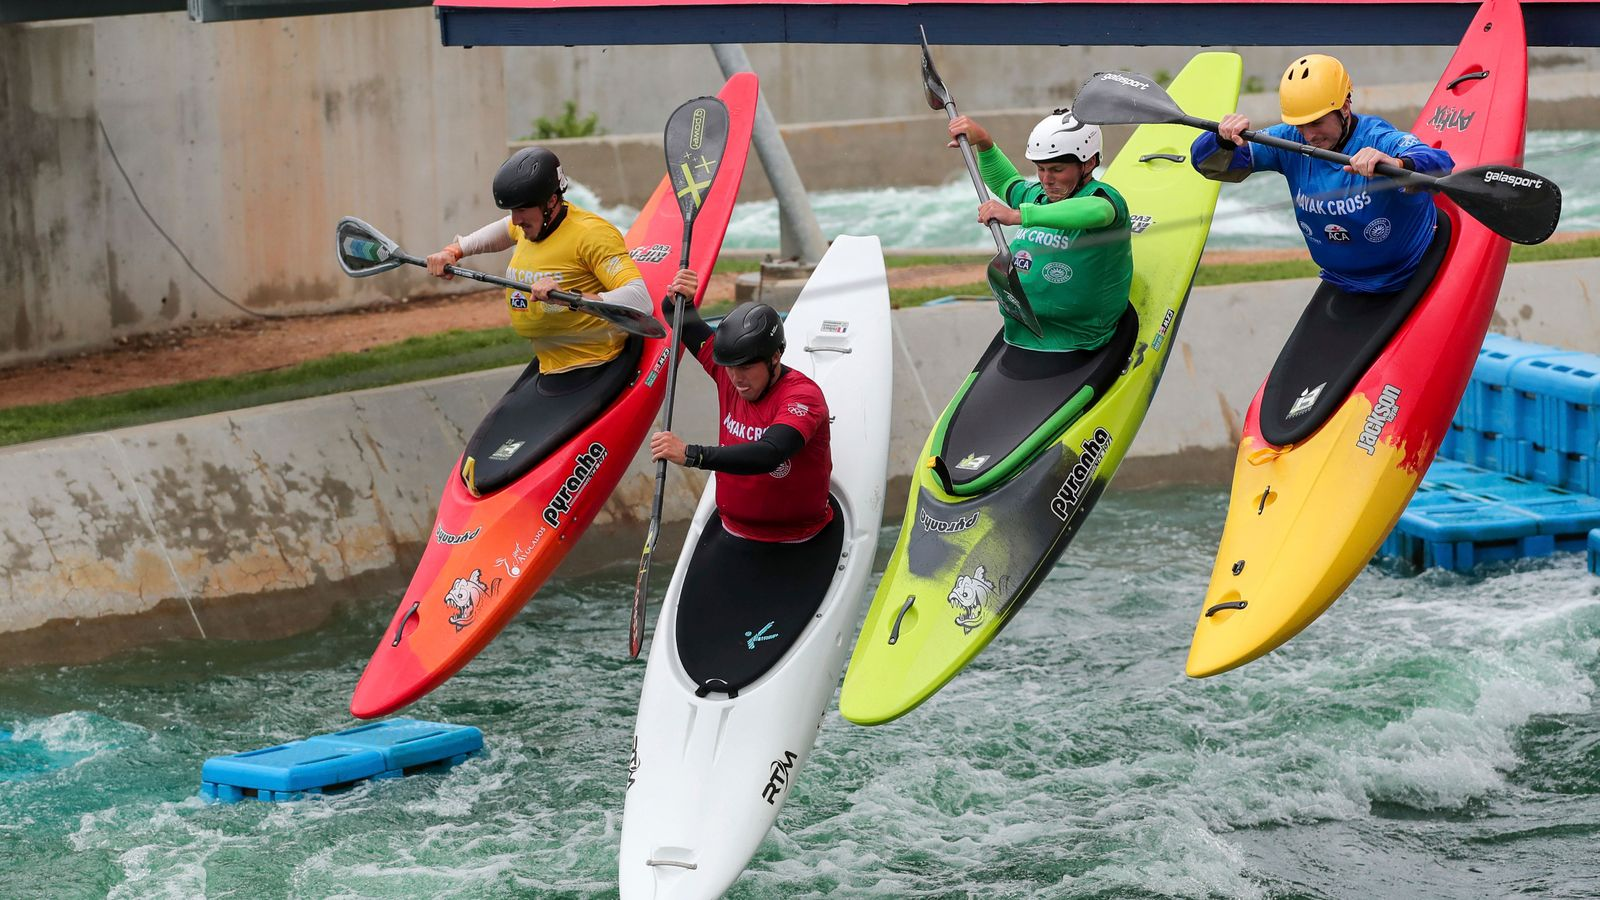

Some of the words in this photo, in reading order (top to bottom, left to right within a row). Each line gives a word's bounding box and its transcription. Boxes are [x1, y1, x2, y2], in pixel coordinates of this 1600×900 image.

[1100, 73, 1150, 90] galasport
[1484, 171, 1543, 189] galasport
[1327, 191, 1372, 215] CROSS
[1028, 230, 1069, 250] CROSS
[1328, 231, 1351, 242] ACA
[1013, 258, 1029, 270] ACA
[543, 442, 606, 529] pyranha
[1051, 427, 1110, 522] pyranha
[920, 507, 980, 532] pyranha
[762, 750, 798, 805] RTM
